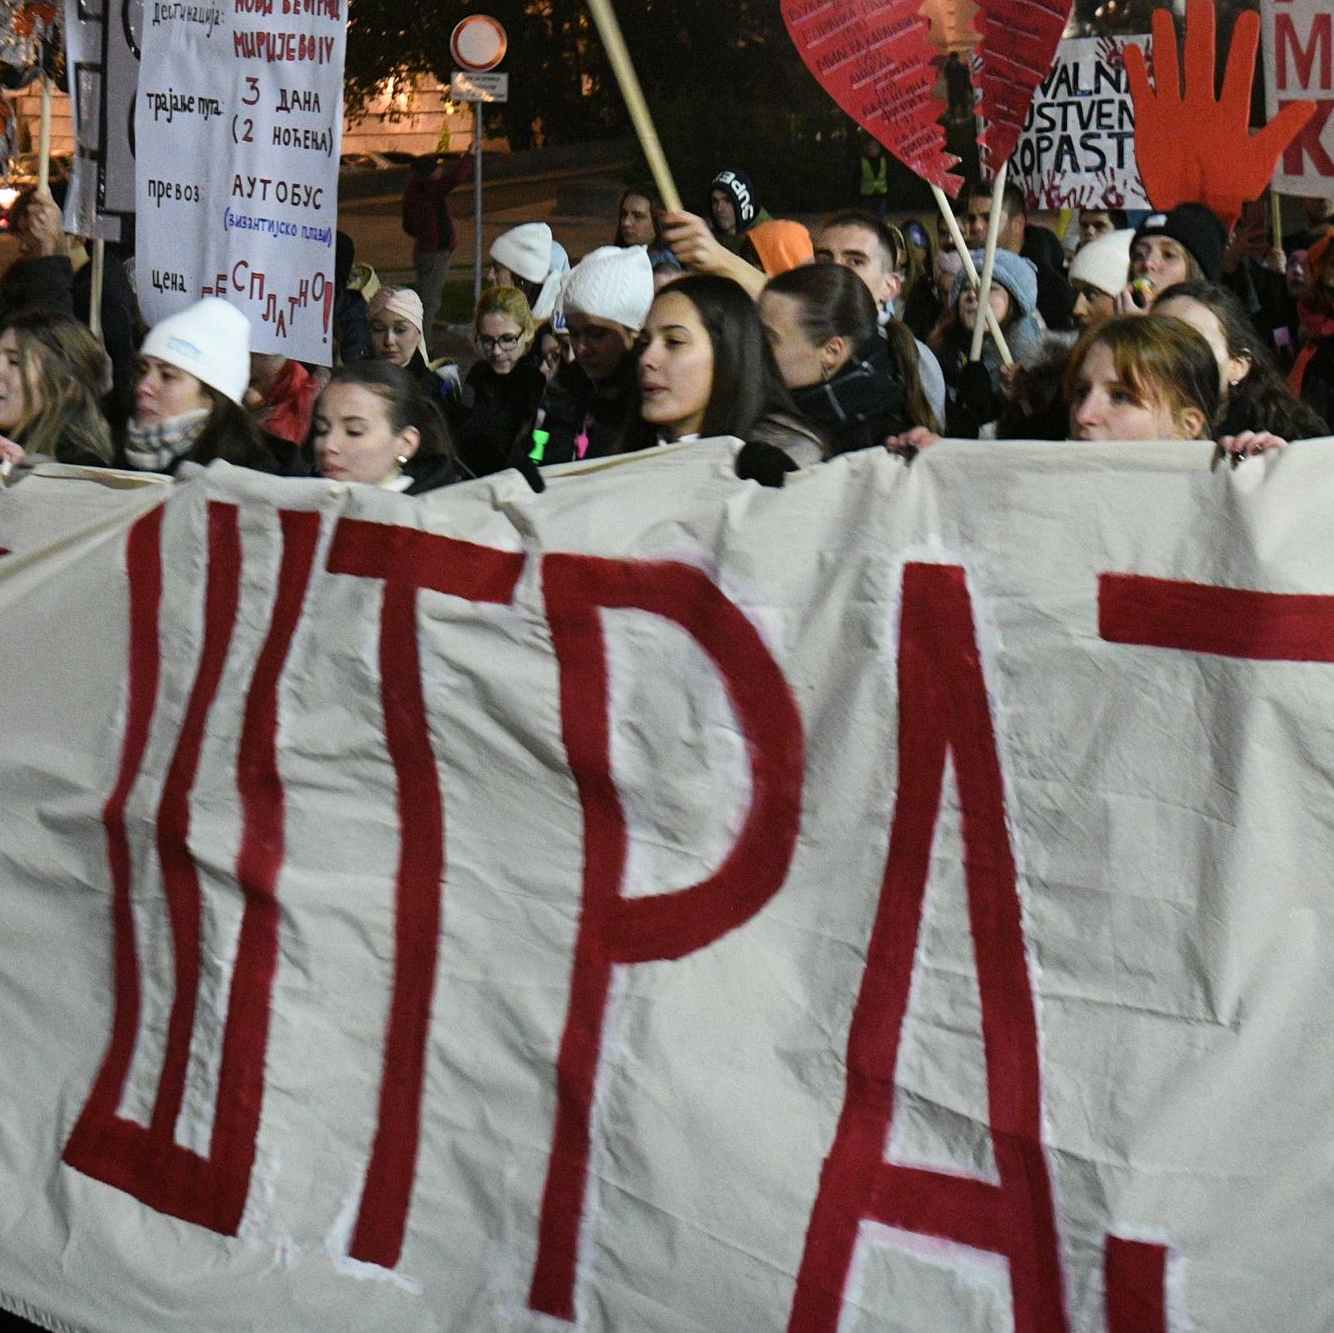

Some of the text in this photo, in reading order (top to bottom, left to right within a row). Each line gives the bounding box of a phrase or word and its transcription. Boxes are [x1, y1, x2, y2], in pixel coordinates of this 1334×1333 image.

[152, 1, 225, 38] дестинација:
[233, 29, 316, 63] МИРИЈЕВО
[146, 87, 195, 123] трајање
[241, 77, 261, 106] 3
[275, 88, 321, 114] ДАНА
[272, 125, 334, 158] НОЋЕЊА)
[231, 174, 324, 210] АУТОБУС
[712, 170, 755, 221] SUPE
